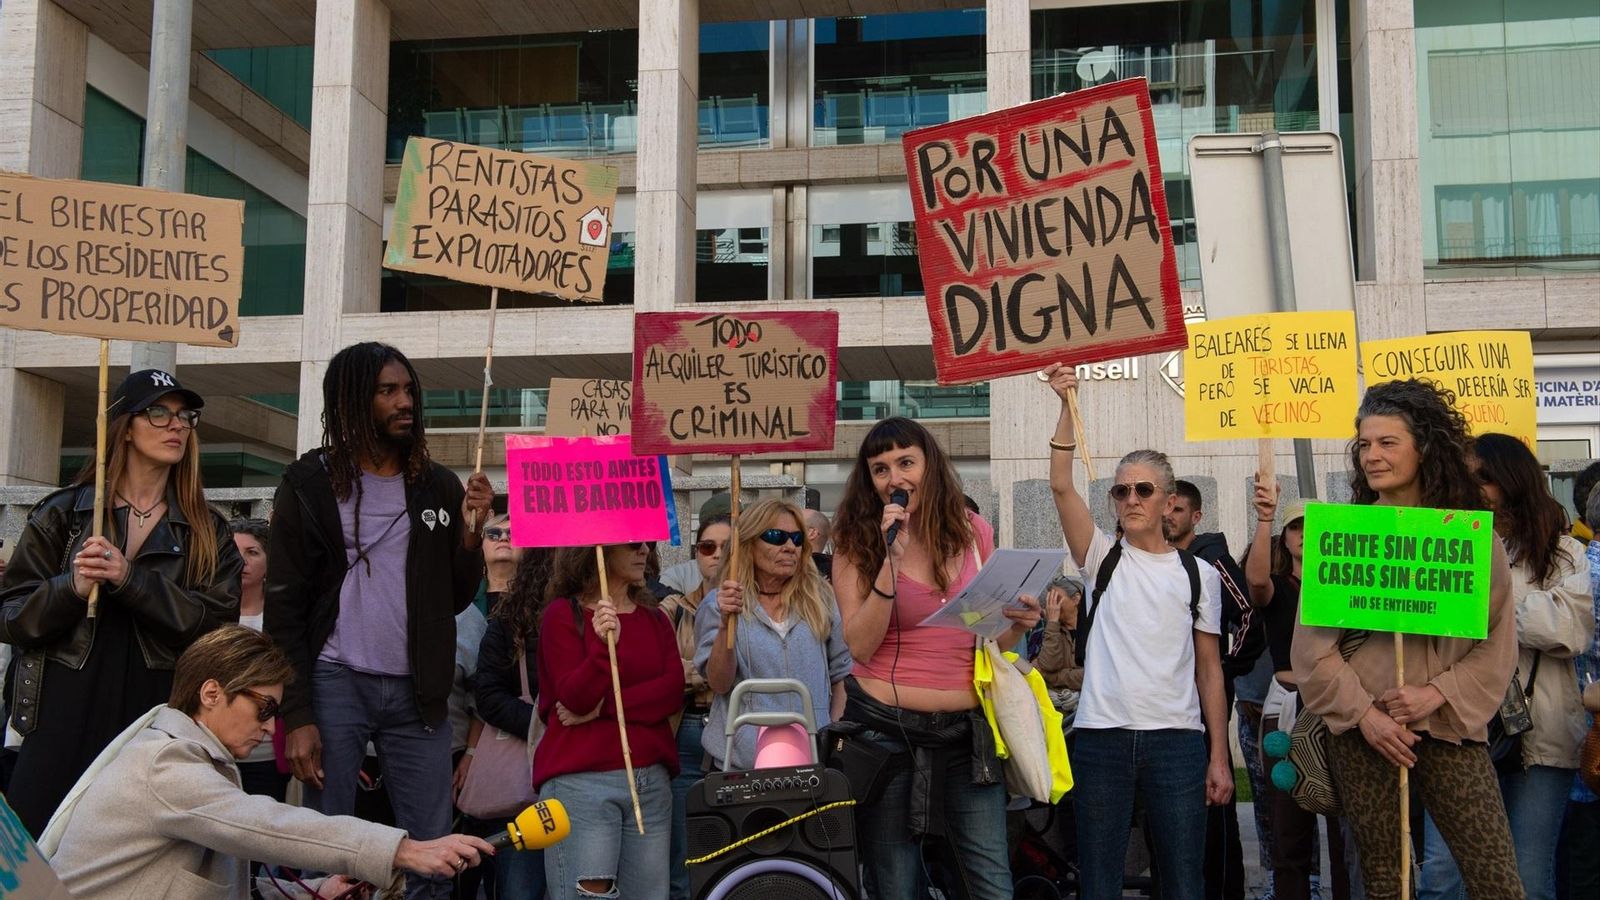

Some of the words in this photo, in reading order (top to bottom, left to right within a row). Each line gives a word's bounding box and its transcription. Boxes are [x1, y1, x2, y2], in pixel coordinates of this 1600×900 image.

[1020, 106, 1135, 181] UNA
[426, 141, 583, 204] RENTISTAS
[0, 190, 33, 224] EL
[51, 195, 207, 242] BIENESTAR
[429, 185, 567, 243] PARASITOS
[939, 169, 1160, 272] VIVIENDA
[27, 239, 69, 270] LOS
[77, 240, 229, 283] RESIDENTES
[412, 224, 592, 293] EXPLOTADORES
[0, 282, 23, 312] S
[41, 277, 228, 330] PROSPERIDAD
[945, 254, 1155, 356] DIGNA
[696, 315, 762, 349] TODO
[1195, 326, 1272, 359] BALEARES
[1285, 333, 1299, 351] SE
[1306, 332, 1347, 350] LLENA
[646, 347, 733, 383] ALQUILER
[1221, 362, 1235, 379] DE
[1372, 343, 1474, 378] CONSEGUIR
[1478, 343, 1512, 370] UNA
[150, 371, 175, 387] NY
[582, 379, 631, 401] CASAS
[723, 381, 751, 405] ES
[1200, 381, 1235, 401] PERO
[1253, 377, 1270, 395] SE
[1457, 373, 1509, 397] DEBERÍA
[1513, 377, 1532, 398] SER
[571, 398, 609, 421] PARA
[1220, 409, 1237, 428] DE
[1252, 400, 1321, 425] VECINOS
[1544, 393, 1600, 407] MATÈRI
[597, 422, 619, 436] NO
[670, 406, 810, 440] CRIMINAL
[521, 461, 562, 482] TODO
[565, 460, 604, 481] ESTO
[608, 457, 656, 479] ANTES
[523, 485, 569, 514] ERA
[573, 480, 661, 513] BARRIO
[1319, 531, 1379, 559] GENTE
[1383, 534, 1417, 561] SIN
[1421, 537, 1474, 565] CASA
[1318, 561, 1375, 587] CASAS
[1379, 564, 1411, 590] SIN
[1415, 567, 1475, 594] GENTE
[1349, 595, 1366, 610] ¡NO
[1370, 596, 1381, 611] SE
[1383, 597, 1437, 615] ENTIENDE!
